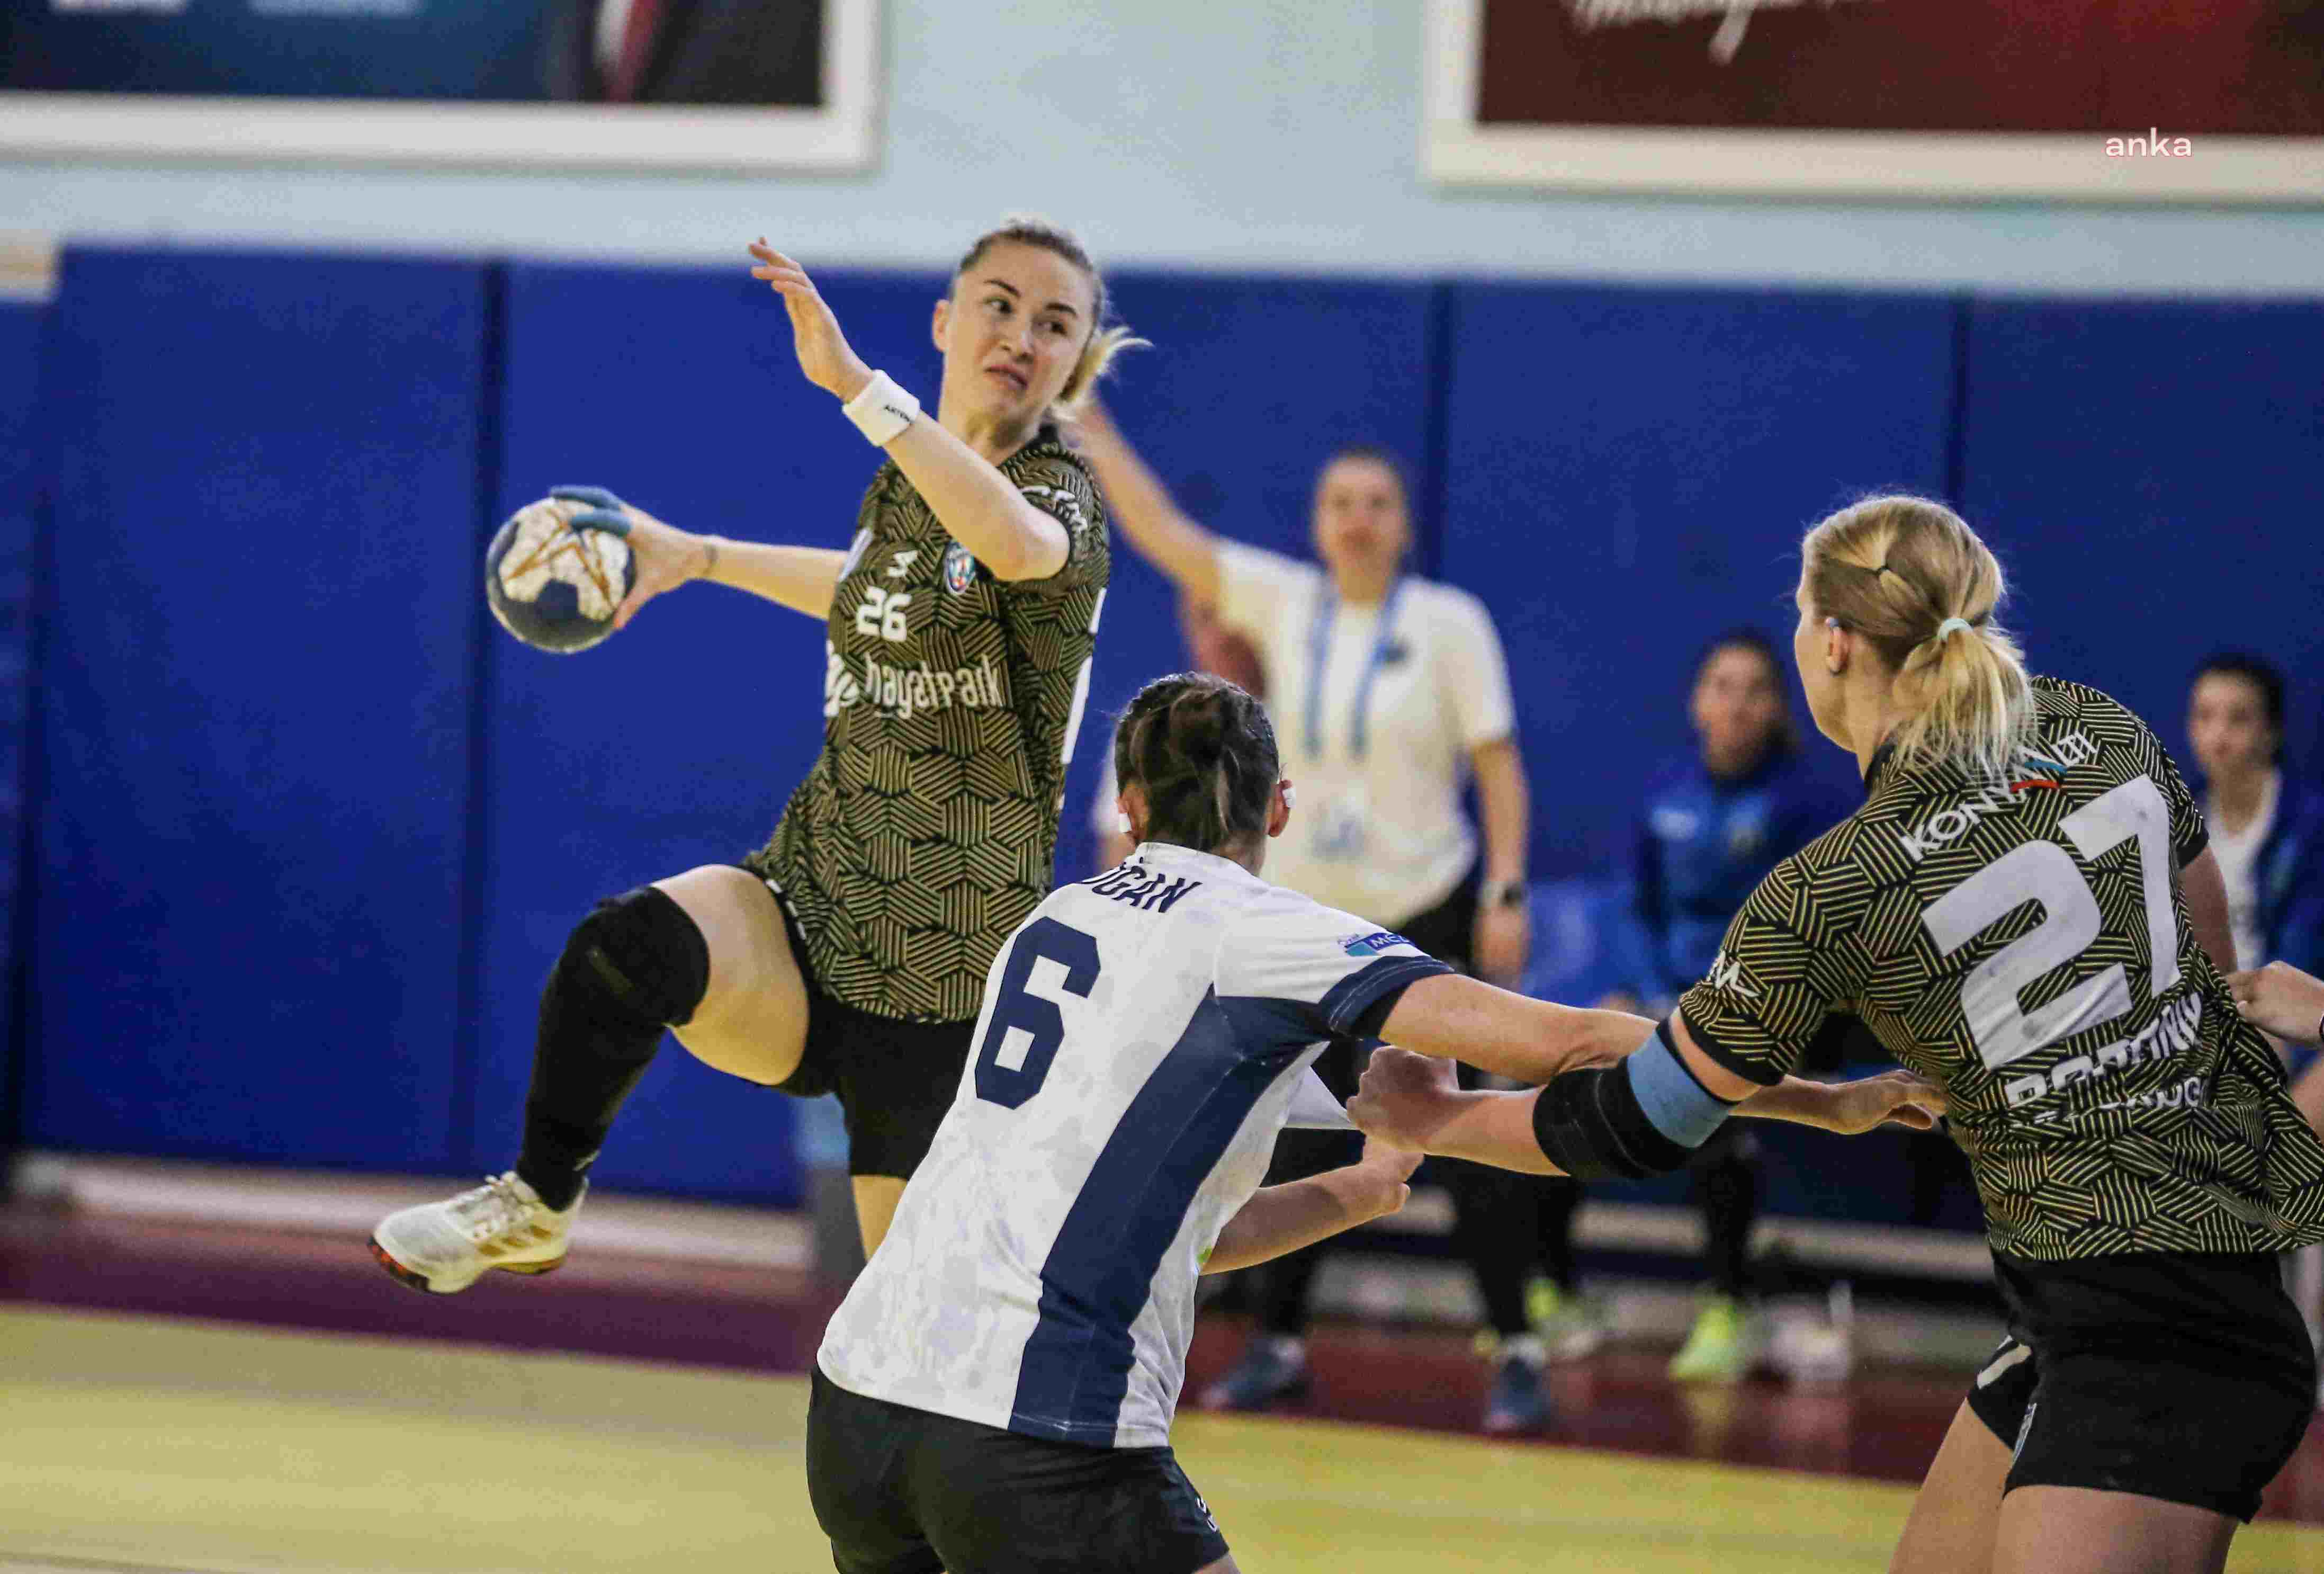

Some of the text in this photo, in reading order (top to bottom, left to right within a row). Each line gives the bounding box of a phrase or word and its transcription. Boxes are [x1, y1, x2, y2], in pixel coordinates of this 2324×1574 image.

[856, 585, 912, 641] 26
[975, 916, 1101, 1110] 6
[1921, 774, 2182, 1072] 27
